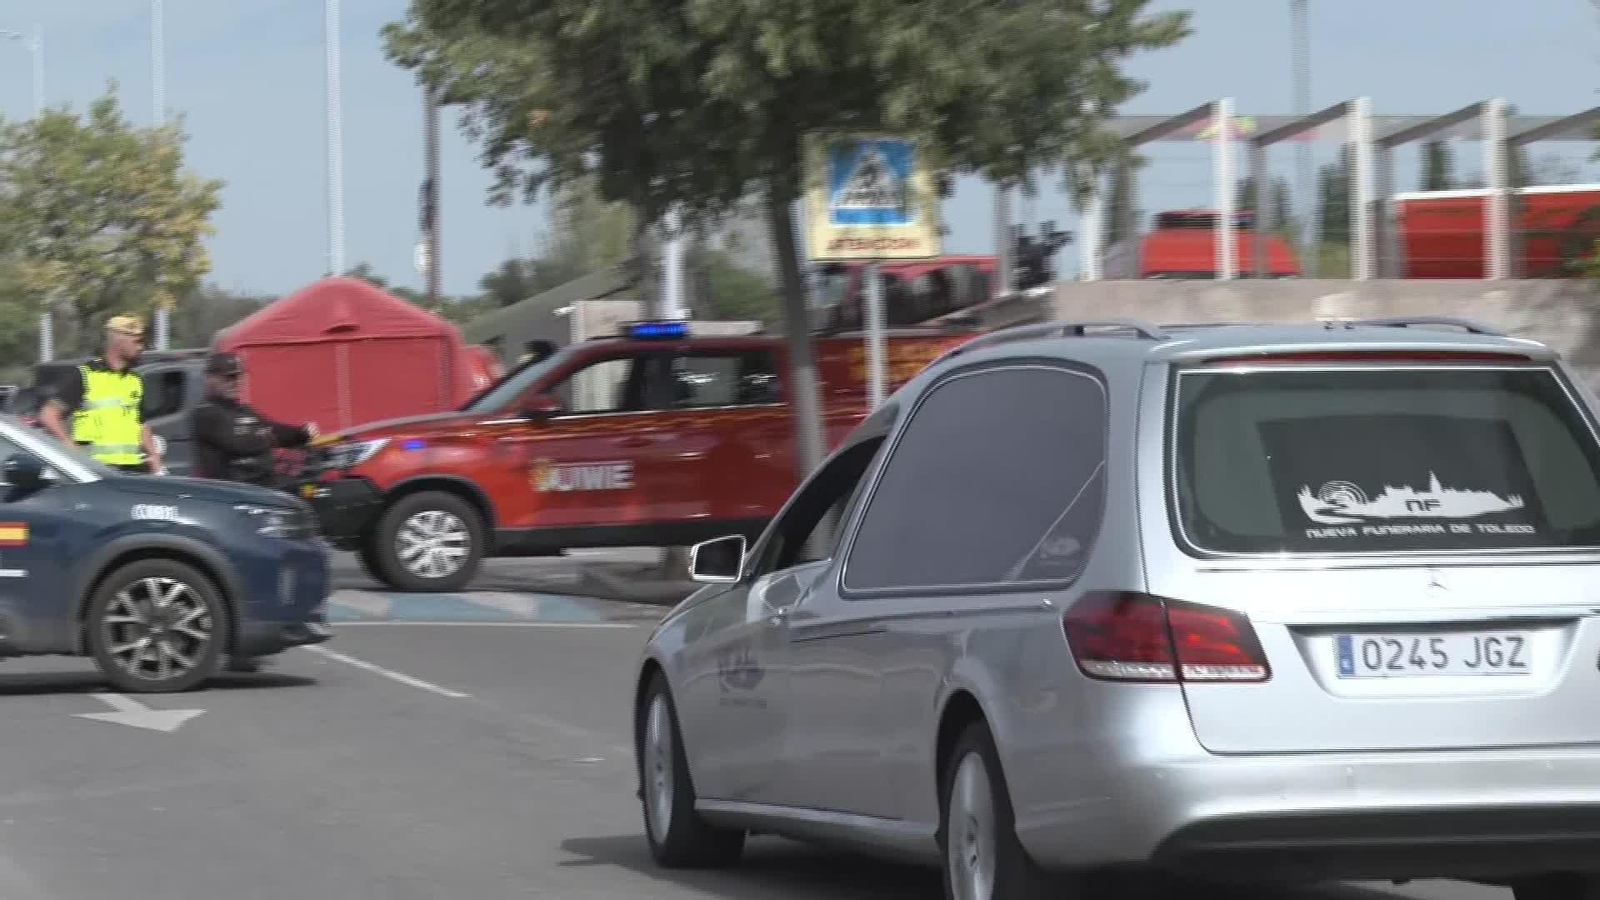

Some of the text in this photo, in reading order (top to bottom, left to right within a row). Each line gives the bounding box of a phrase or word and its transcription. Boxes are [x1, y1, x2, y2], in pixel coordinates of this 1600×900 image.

[1305, 523, 1537, 539] NUEVA FUNERARIA DE TOLEDO
[1361, 636, 1528, 670] 0245 JGZ
